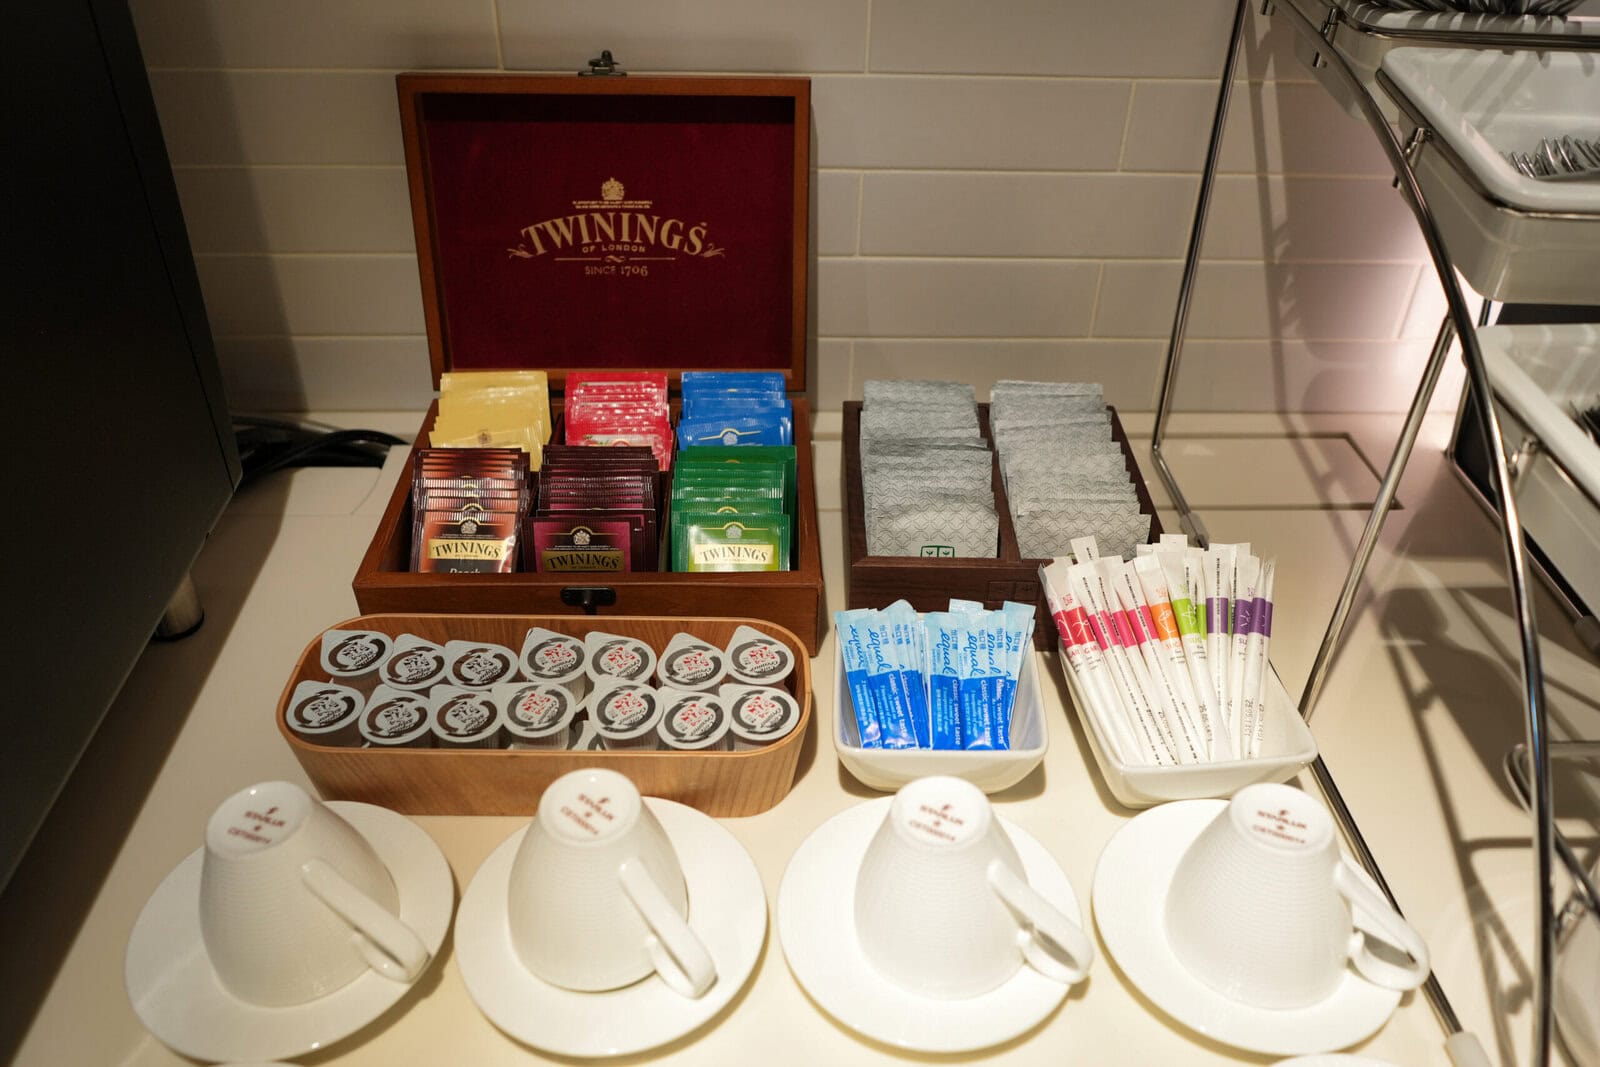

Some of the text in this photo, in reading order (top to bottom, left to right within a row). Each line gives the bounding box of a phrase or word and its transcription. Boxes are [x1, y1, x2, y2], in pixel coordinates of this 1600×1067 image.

[521, 212, 708, 256] TWININGS
[583, 244, 646, 254] OF LONDON
[585, 265, 648, 277] SINCE 1706
[432, 542, 501, 558] TWININGS
[701, 546, 768, 562] TWININGS
[547, 553, 619, 569] TWININGS
[867, 628, 892, 673] equal
[936, 628, 956, 675] equal
[963, 631, 985, 676] equal
[981, 680, 989, 701] classic
[894, 696, 903, 717] sweet
